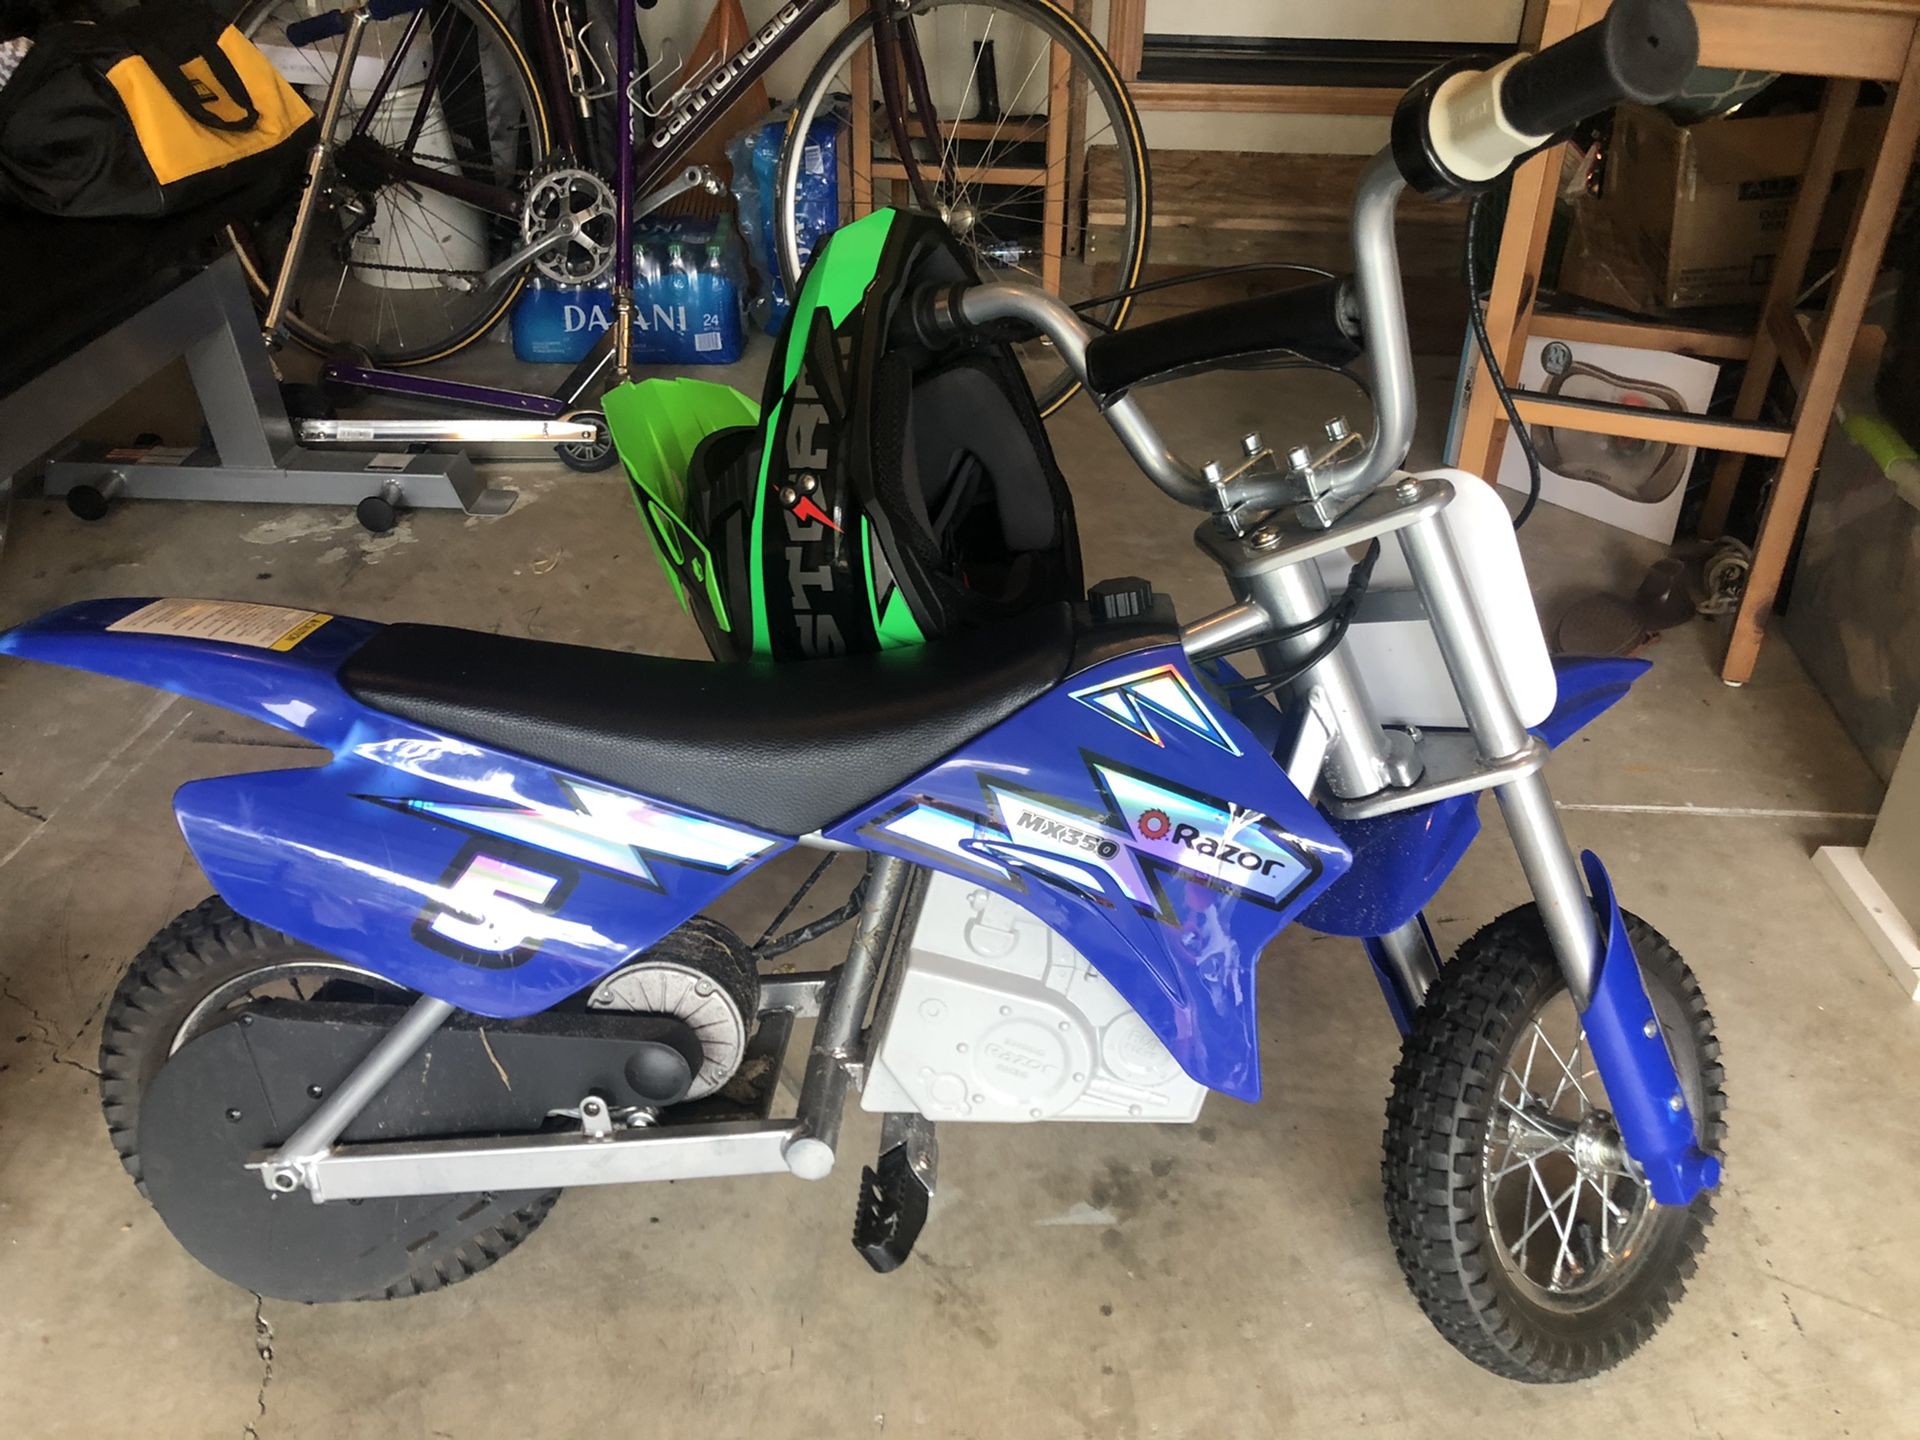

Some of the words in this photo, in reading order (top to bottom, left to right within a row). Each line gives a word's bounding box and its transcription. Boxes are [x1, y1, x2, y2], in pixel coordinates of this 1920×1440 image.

[652, 3, 800, 148] cannondale
[563, 304, 688, 332] DAANI
[703, 313, 720, 327] 24
[1016, 809, 1121, 861] MX350
[1172, 822, 1285, 877] Razor
